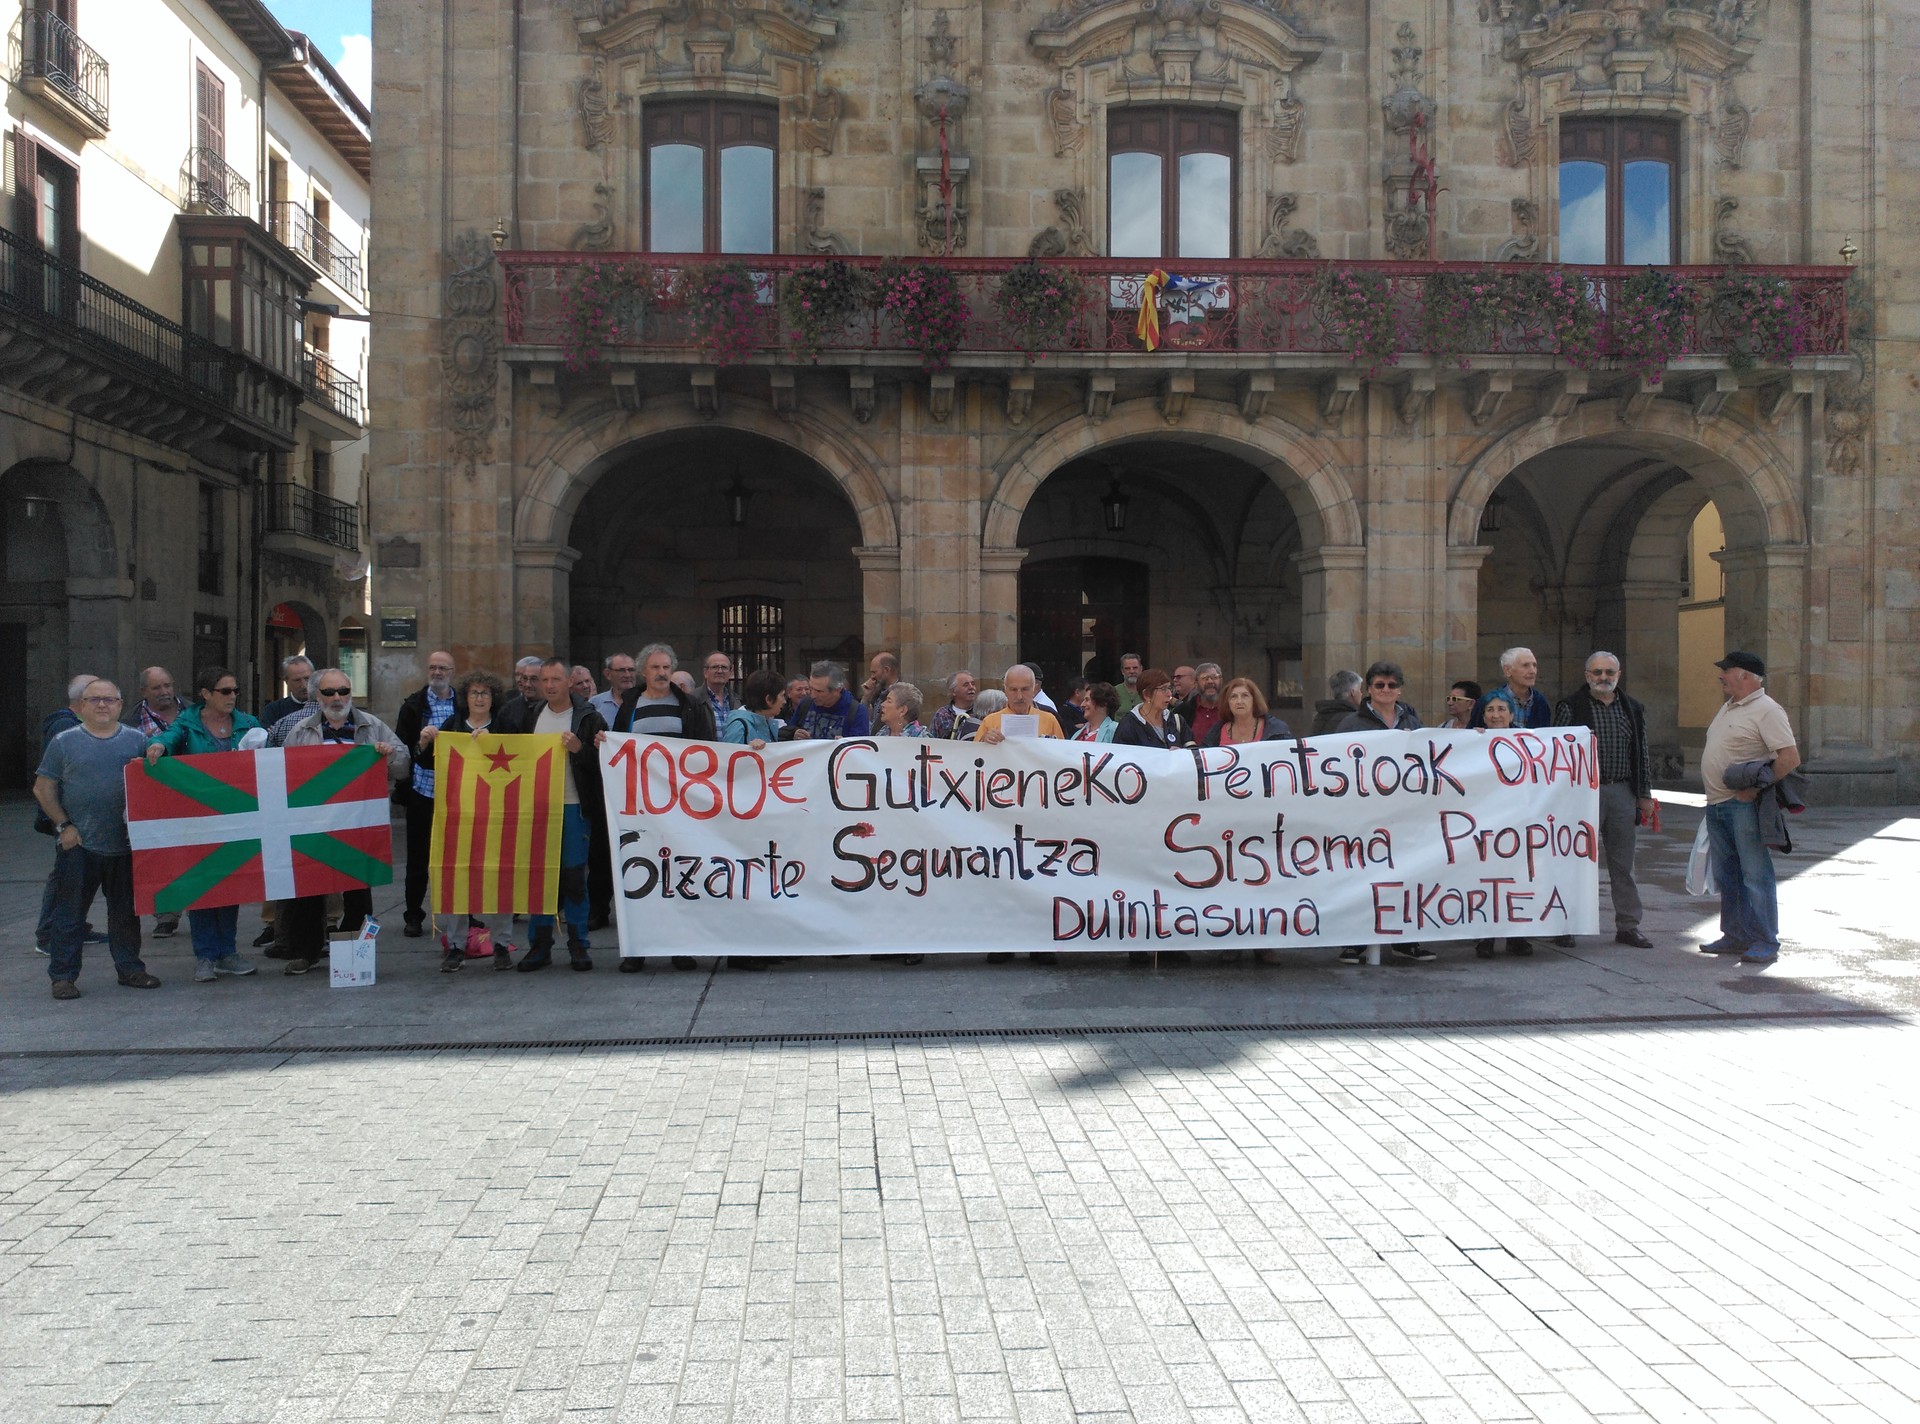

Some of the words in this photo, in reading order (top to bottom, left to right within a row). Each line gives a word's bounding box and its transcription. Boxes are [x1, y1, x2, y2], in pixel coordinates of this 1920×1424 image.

[831, 821, 1100, 898] Segurantza
[1164, 811, 1395, 889] Sistema
[1439, 810, 1598, 882] Propioa
[1052, 888, 1320, 941] Duintasuna
